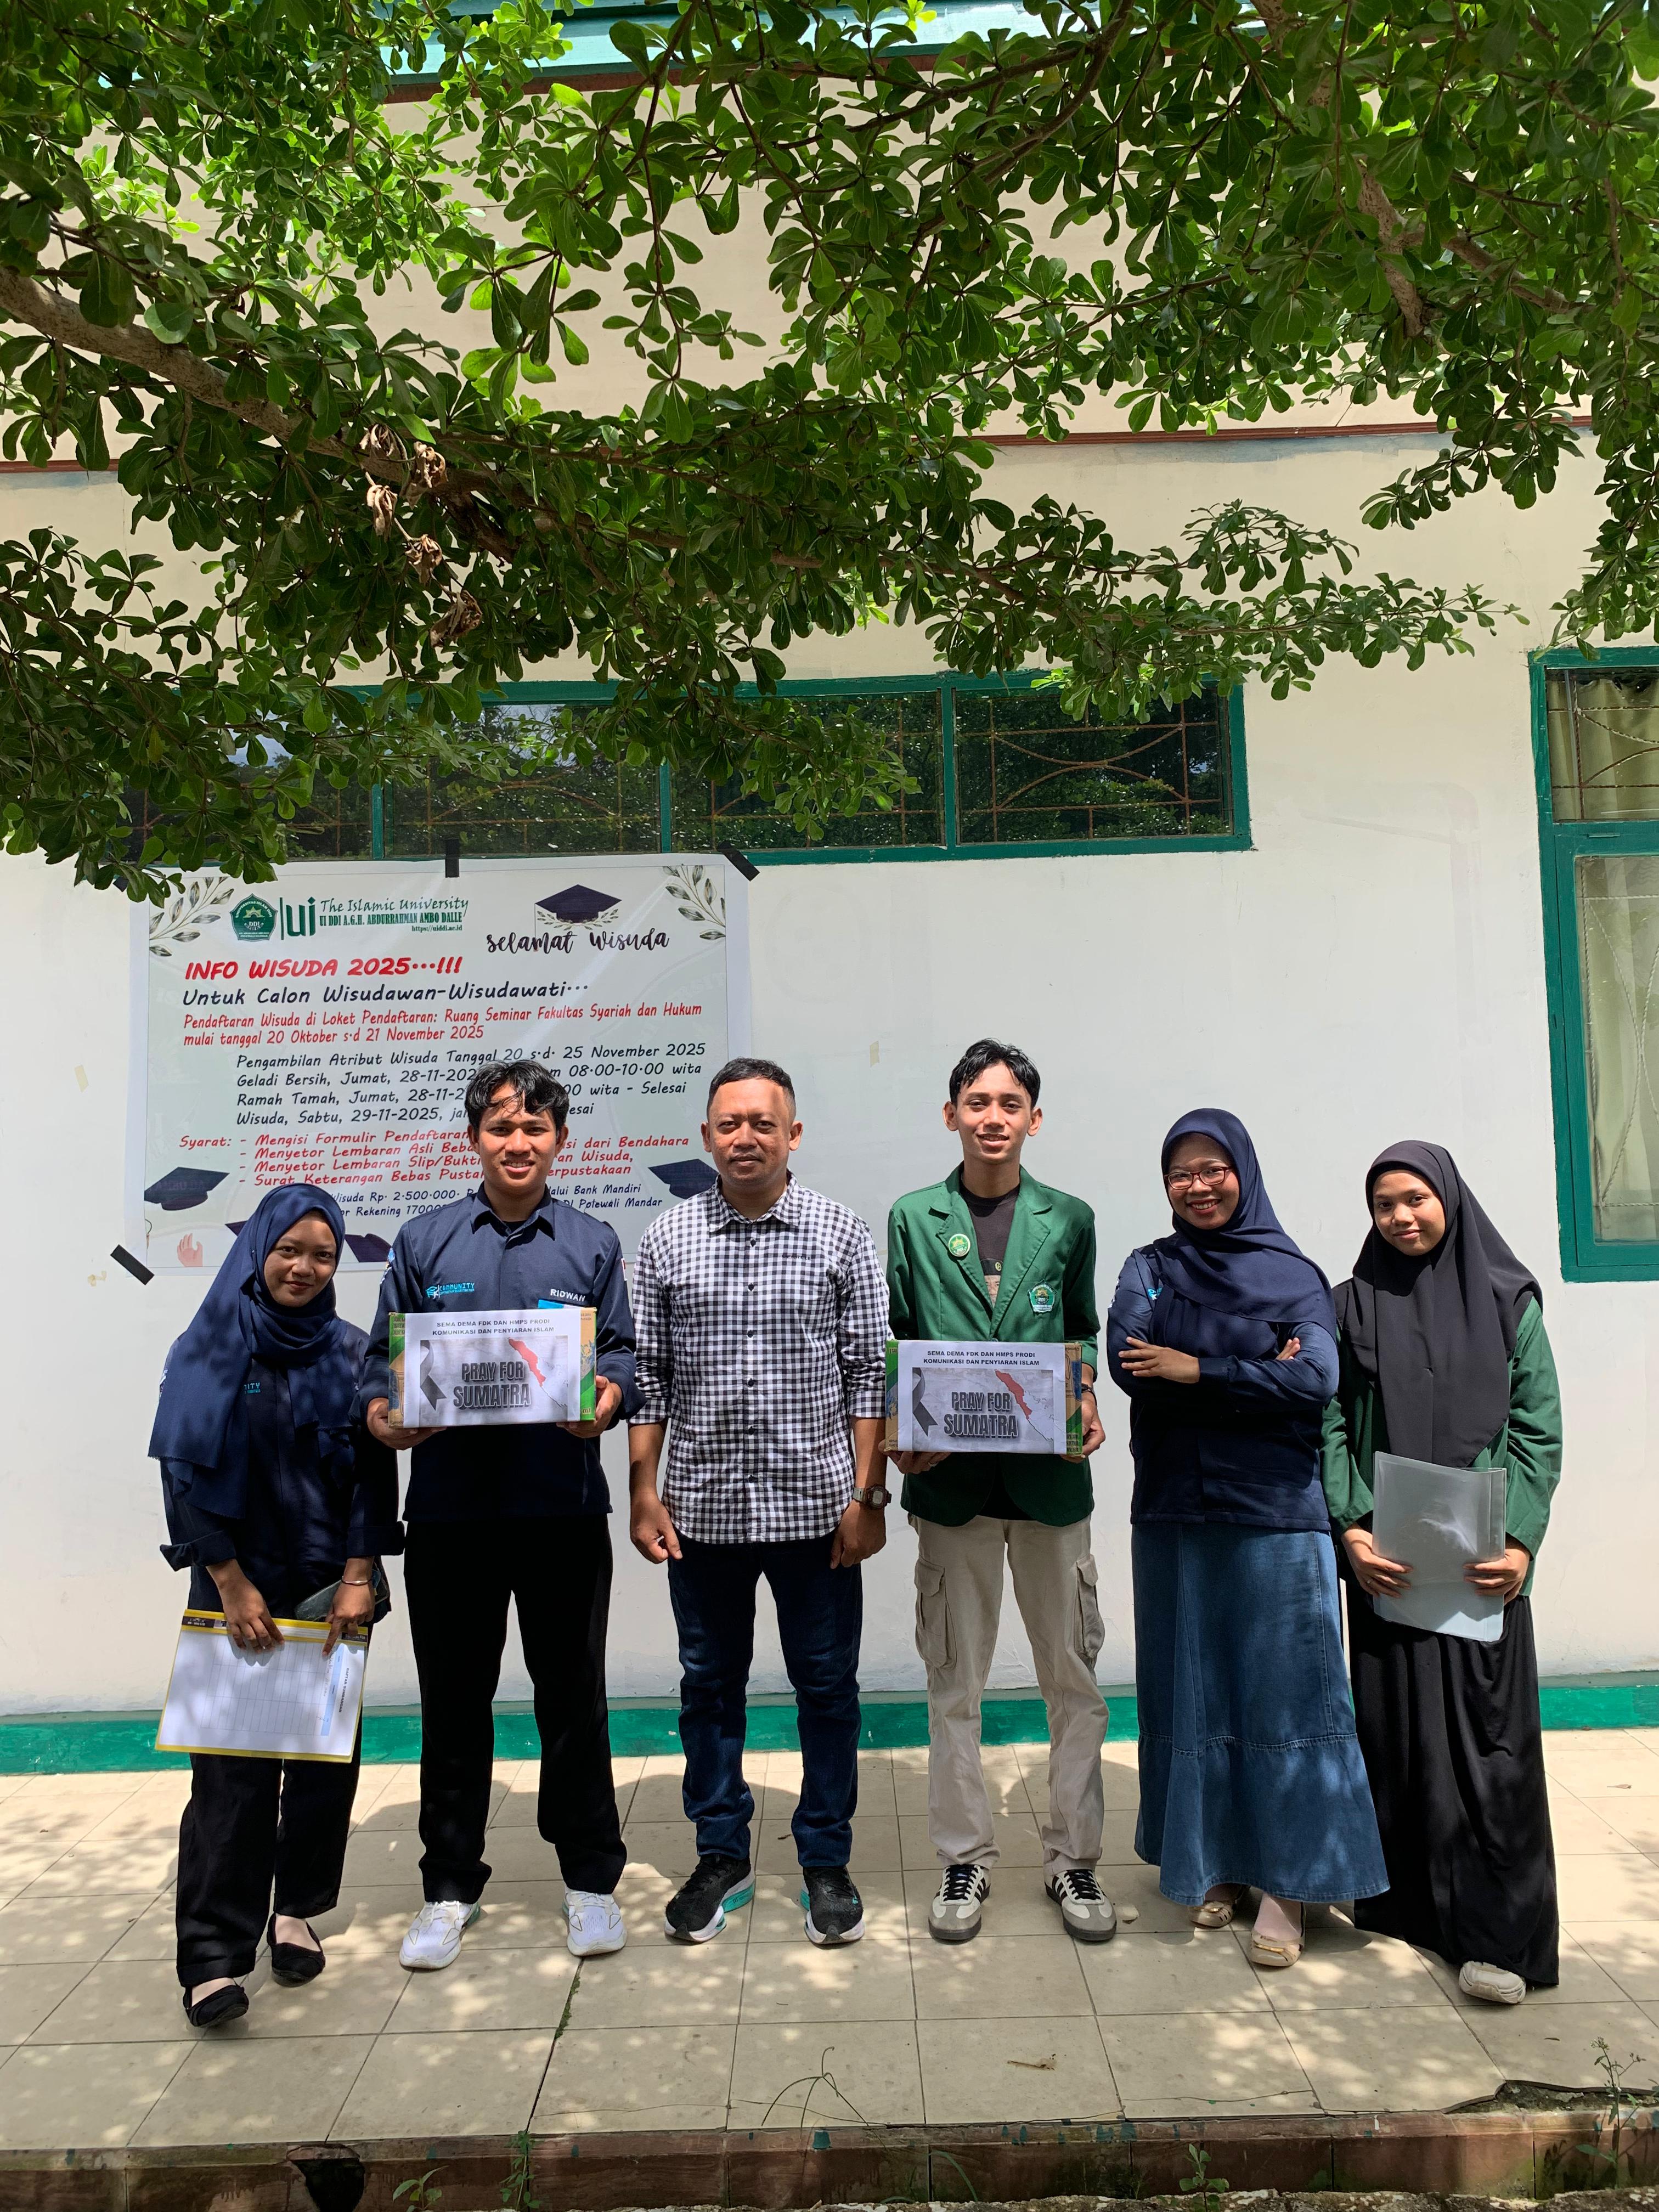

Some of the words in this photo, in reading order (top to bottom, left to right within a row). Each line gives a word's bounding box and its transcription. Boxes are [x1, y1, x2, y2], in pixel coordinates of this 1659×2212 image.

[321, 898, 343, 912] The
[348, 898, 395, 912] Islamic
[399, 896, 468, 917] University
[319, 916, 326, 926] UI
[329, 915, 341, 926] DDI
[343, 915, 365, 926] A.G.H.
[367, 913, 417, 925] ABDURRAHMAN
[419, 912, 439, 923] AMBO
[442, 911, 462, 923] DALLE
[412, 924, 462, 933] https://uiddi.ac.id
[185, 961, 238, 980] INFO
[249, 960, 337, 979] WISUDA
[183, 989, 245, 1005] Untuk
[258, 987, 310, 1003] Calon
[184, 1014, 253, 1028] Pendaftaran
[261, 1012, 300, 1026] Wisuda
[306, 1011, 316, 1025] di
[323, 1012, 355, 1025] Loket
[362, 1009, 437, 1024] Pendaftaran:
[445, 1009, 478, 1025] Ruang
[486, 1007, 532, 1021] Seminar
[538, 1005, 583, 1019] Fakultas
[590, 1003, 631, 1021] Syariah
[637, 1002, 657, 1016] dan
[664, 1002, 701, 1016] Hukum
[184, 1032, 214, 1046] mulai
[221, 1031, 262, 1048] tanggal
[267, 1031, 284, 1043] 20
[291, 1029, 337, 1043] Oktober
[366, 1028, 380, 1041] 21
[387, 1026, 445, 1041] November
[450, 1025, 484, 1039] 2025
[237, 1054, 320, 1070] Pengambilan
[330, 1053, 382, 1065] Atribut
[391, 1051, 437, 1064] Wisuda
[447, 1049, 497, 1065] Tanggal
[503, 1048, 522, 1060] 20
[563, 1046, 583, 1058] 25
[591, 1045, 659, 1057] November
[666, 1043, 706, 1056] 2025
[238, 1073, 278, 1086] Geladi
[286, 1073, 330, 1086] Bersih,
[341, 1071, 390, 1085] Jumat,
[400, 1069, 476, 1083] 28-11-202
[673, 1063, 701, 1074] wita
[238, 1093, 282, 1105] Ramah
[292, 1092, 339, 1105] Tamah,
[349, 1091, 398, 1103] Jumat,
[408, 1088, 464, 1102] 28-11-2
[590, 1084, 619, 1095] wita
[641, 1081, 686, 1093] Selesai
[237, 1111, 287, 1125] Wisuda,
[298, 1110, 342, 1124] Sabtu,
[351, 1108, 442, 1121] 29-11-2025,
[179, 1136, 232, 1150] Syarat:
[255, 1135, 308, 1148] Mengisi
[316, 1132, 376, 1143] Formulir
[384, 1130, 469, 1142] Pendaftaran
[255, 1148, 324, 1161] Menyetor
[332, 1145, 400, 1156] Lembaran
[409, 1143, 433, 1153] Asli
[442, 1141, 473, 1153] Beba
[584, 1137, 611, 1148] dari
[619, 1136, 689, 1147] Bendahara
[255, 1161, 325, 1175] Menyetor
[333, 1158, 399, 1170] Lembaran
[408, 1155, 481, 1169] Slip/Bukti
[582, 1149, 633, 1162] Wisuda,
[255, 1173, 295, 1186] Surat
[304, 1172, 383, 1186] Keterangan
[391, 1170, 431, 1181] Bebas
[548, 1164, 631, 1179] erpustakaan
[574, 1186, 597, 1194] Bank
[603, 1183, 641, 1194] Mandiri
[356, 1206, 400, 1217] Rekening
[625, 1197, 662, 1207] Mandar
[439, 1283, 475, 1291] COMMUNITY
[550, 1289, 585, 1304] RIDWAN
[462, 1363, 496, 1381] PRAY
[500, 1361, 524, 1380] FOR
[453, 1384, 531, 1410] SUMATRA
[951, 1391, 983, 1410] PRAY
[988, 1392, 1011, 1412] FOR
[944, 1413, 1018, 1438] SUMATRA
